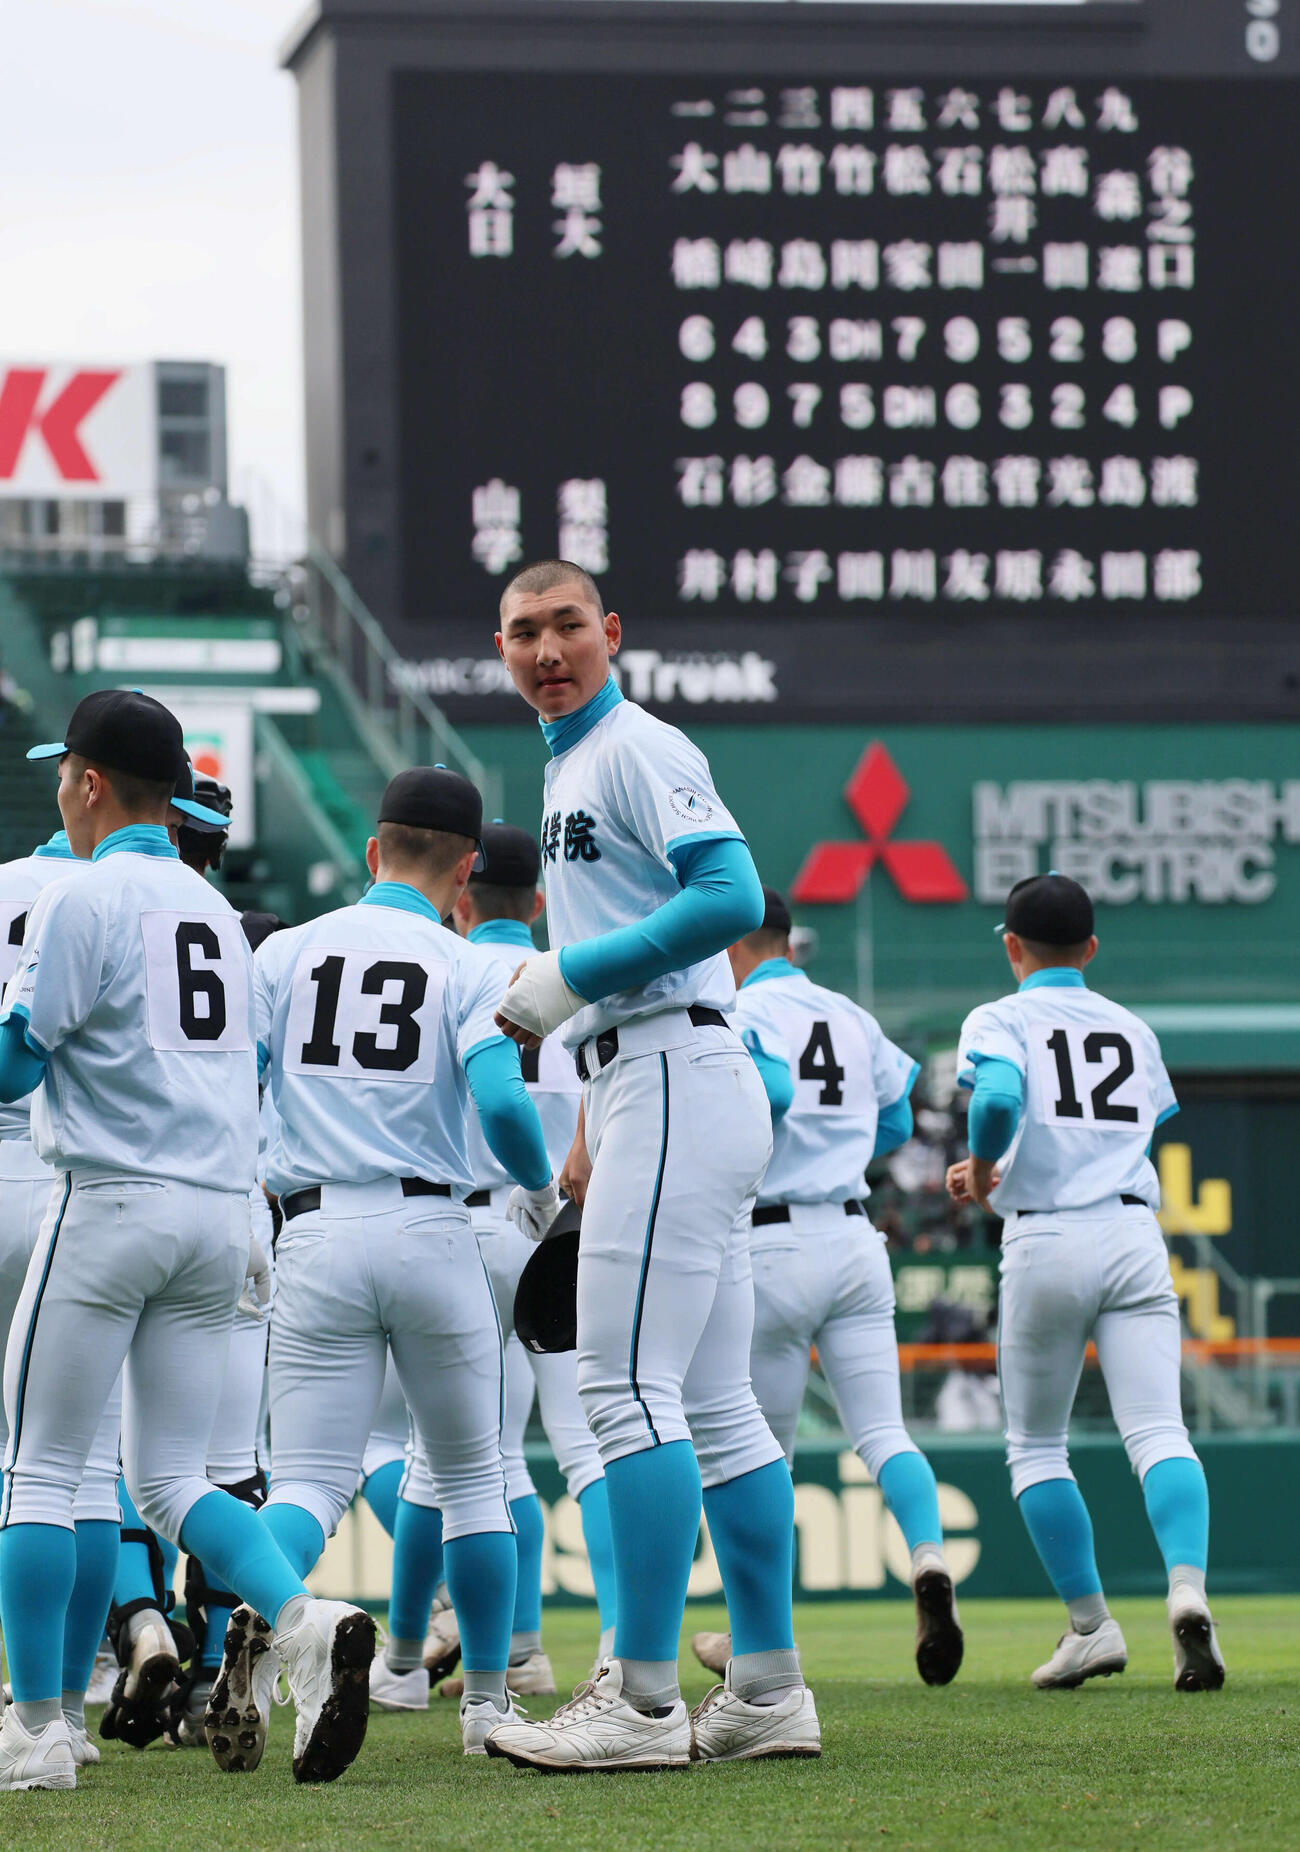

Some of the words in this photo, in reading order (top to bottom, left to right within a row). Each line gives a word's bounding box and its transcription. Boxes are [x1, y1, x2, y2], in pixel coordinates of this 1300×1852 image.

[175, 921, 226, 1041] 6
[301, 955, 429, 1072] 13
[799, 1021, 845, 1106] 4
[1046, 1029, 1139, 1123] 12
